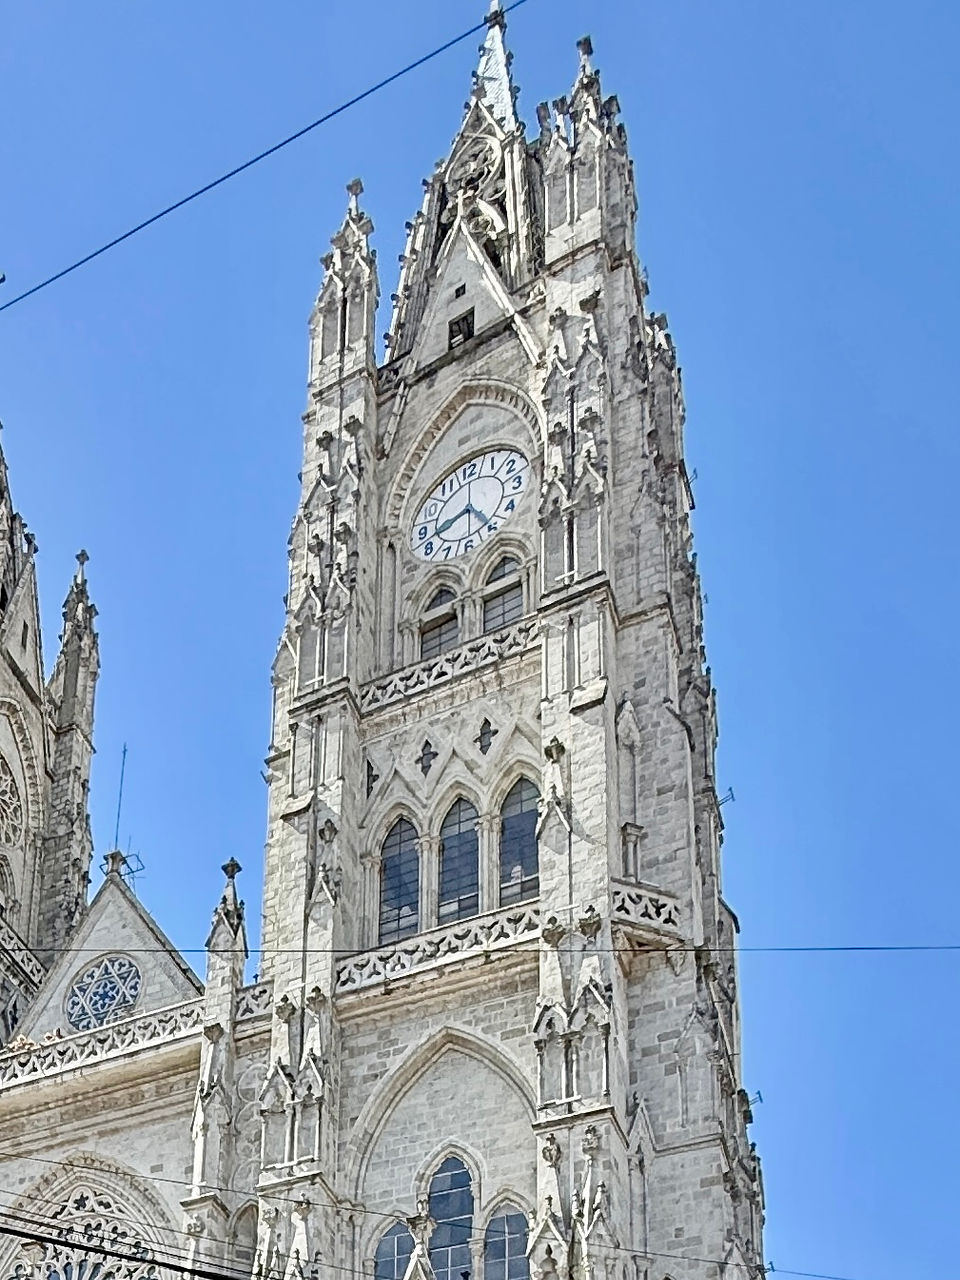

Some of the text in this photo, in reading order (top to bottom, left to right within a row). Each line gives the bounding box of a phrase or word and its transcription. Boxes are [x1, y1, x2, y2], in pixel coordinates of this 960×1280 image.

[491, 457, 494, 470] 1
[506, 459, 516, 474] 2
[463, 464, 477, 480] 12
[442, 479, 453, 496] 11
[513, 476, 522, 490] 3
[424, 504, 437, 519] 10
[505, 499, 515, 511] 4
[419, 527, 427, 540] 9
[424, 542, 433, 555] 8
[443, 547, 451, 560] 7
